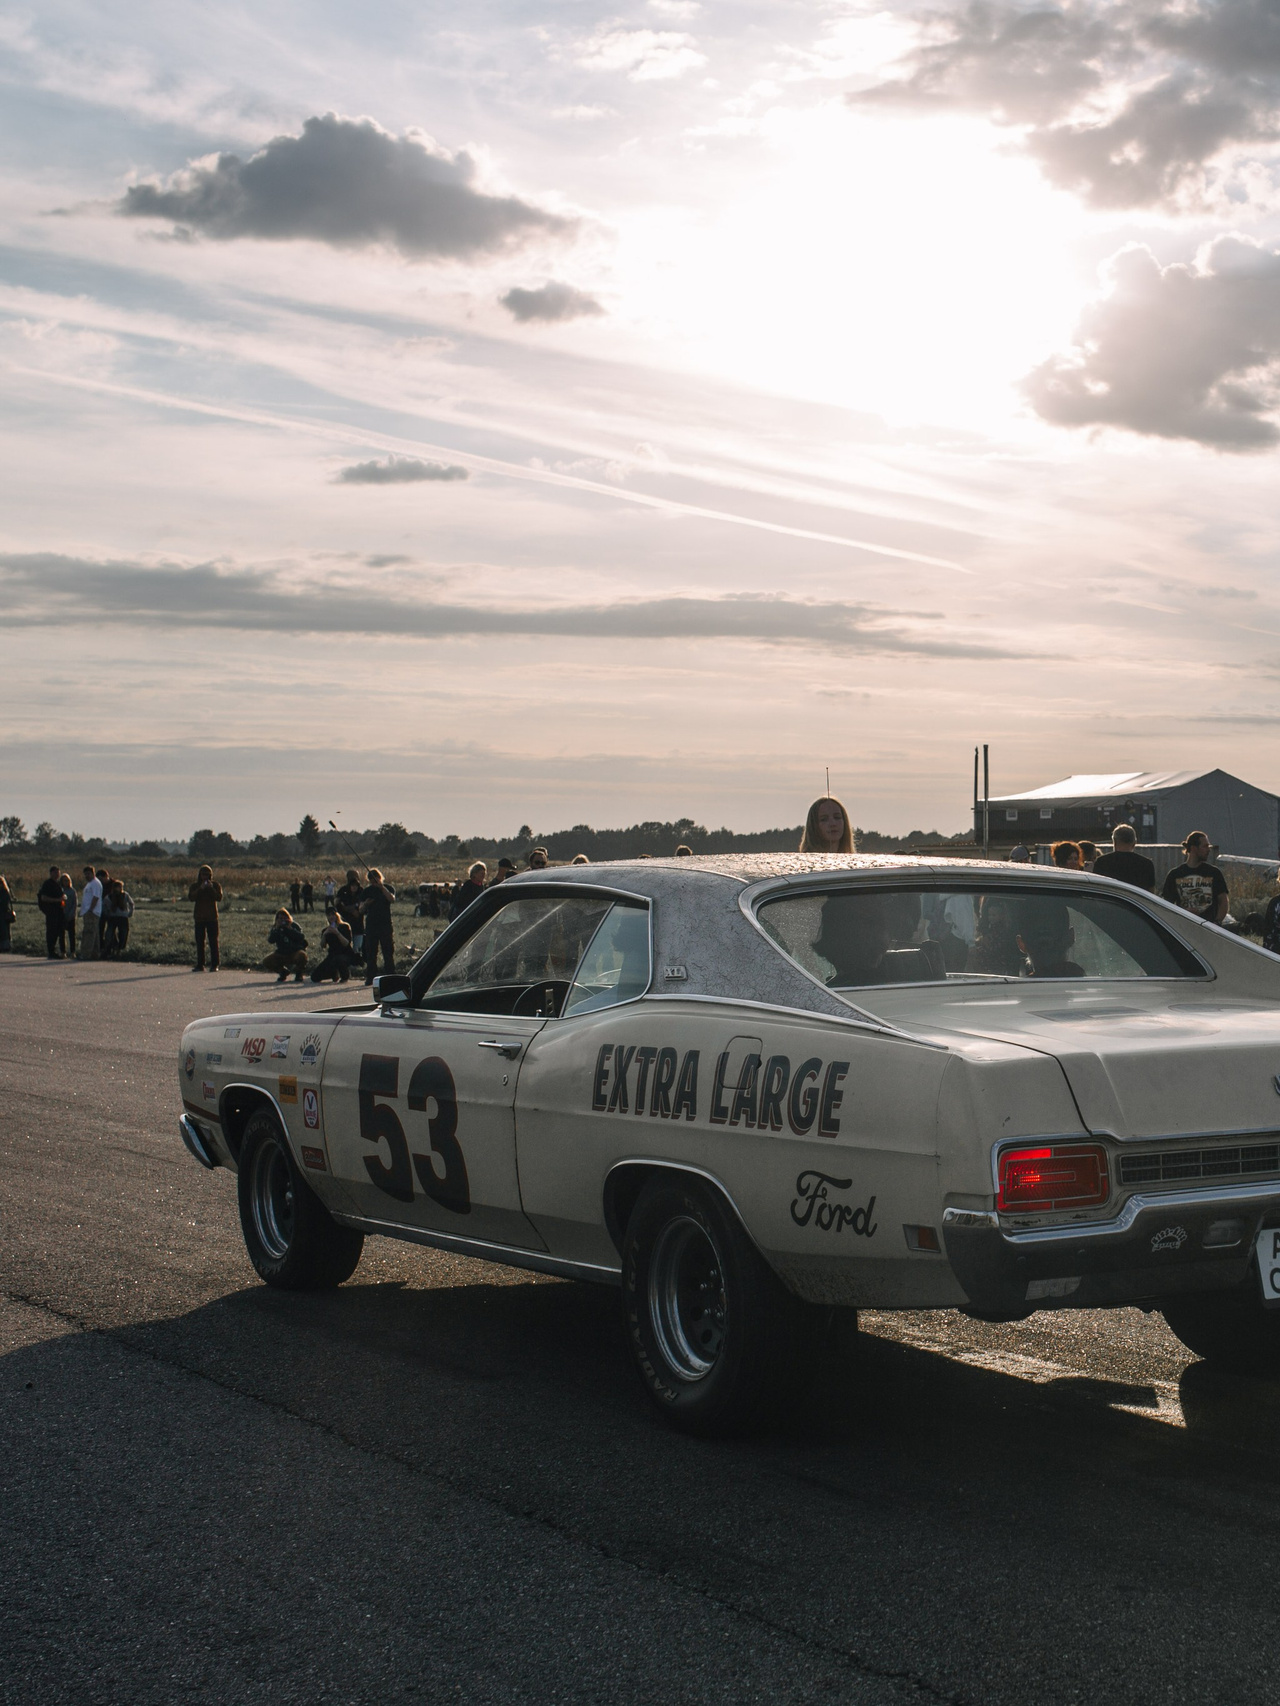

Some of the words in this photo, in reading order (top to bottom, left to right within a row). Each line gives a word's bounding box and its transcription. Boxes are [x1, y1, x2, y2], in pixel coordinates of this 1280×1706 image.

[241, 1037, 266, 1056] MSD
[592, 1043, 700, 1121] EXTRA
[709, 1051, 850, 1138] LARGE
[358, 1053, 471, 1215] 53
[790, 1170, 878, 1237] Ford
